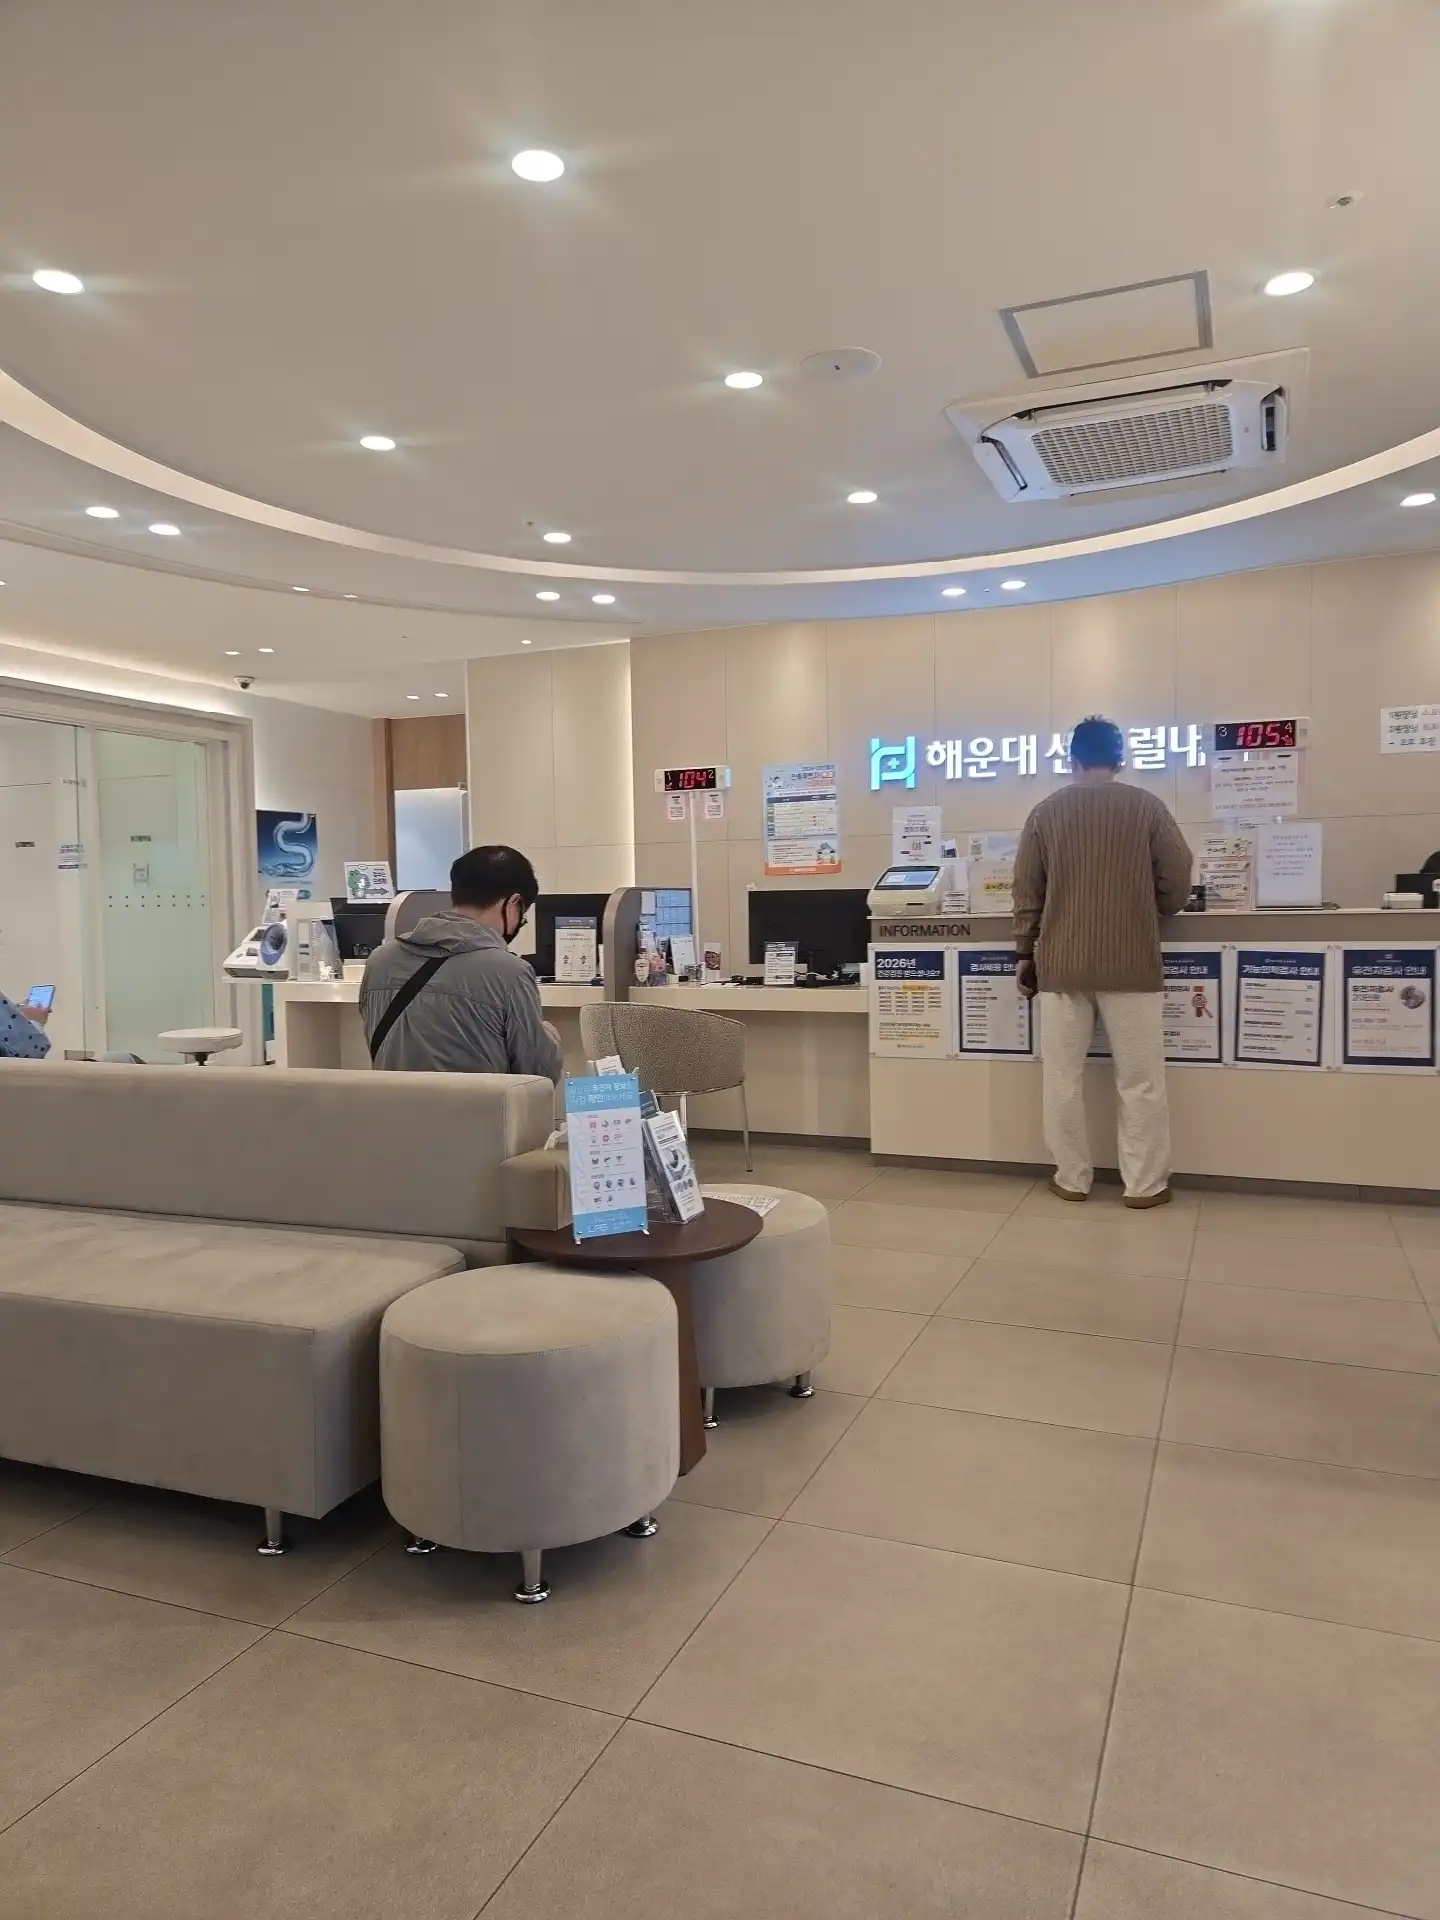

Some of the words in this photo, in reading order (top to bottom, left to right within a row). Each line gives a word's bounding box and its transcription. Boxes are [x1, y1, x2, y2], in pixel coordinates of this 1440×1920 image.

[1218, 726, 1229, 738] 3
[1284, 722, 1294, 734] 4
[1234, 723, 1281, 747] 105
[925, 734, 1038, 779] 해운대
[678, 771, 707, 789] 104
[707, 769, 715, 779] 2
[879, 924, 971, 938] INFORMATION
[876, 958, 916, 969] 2026년
